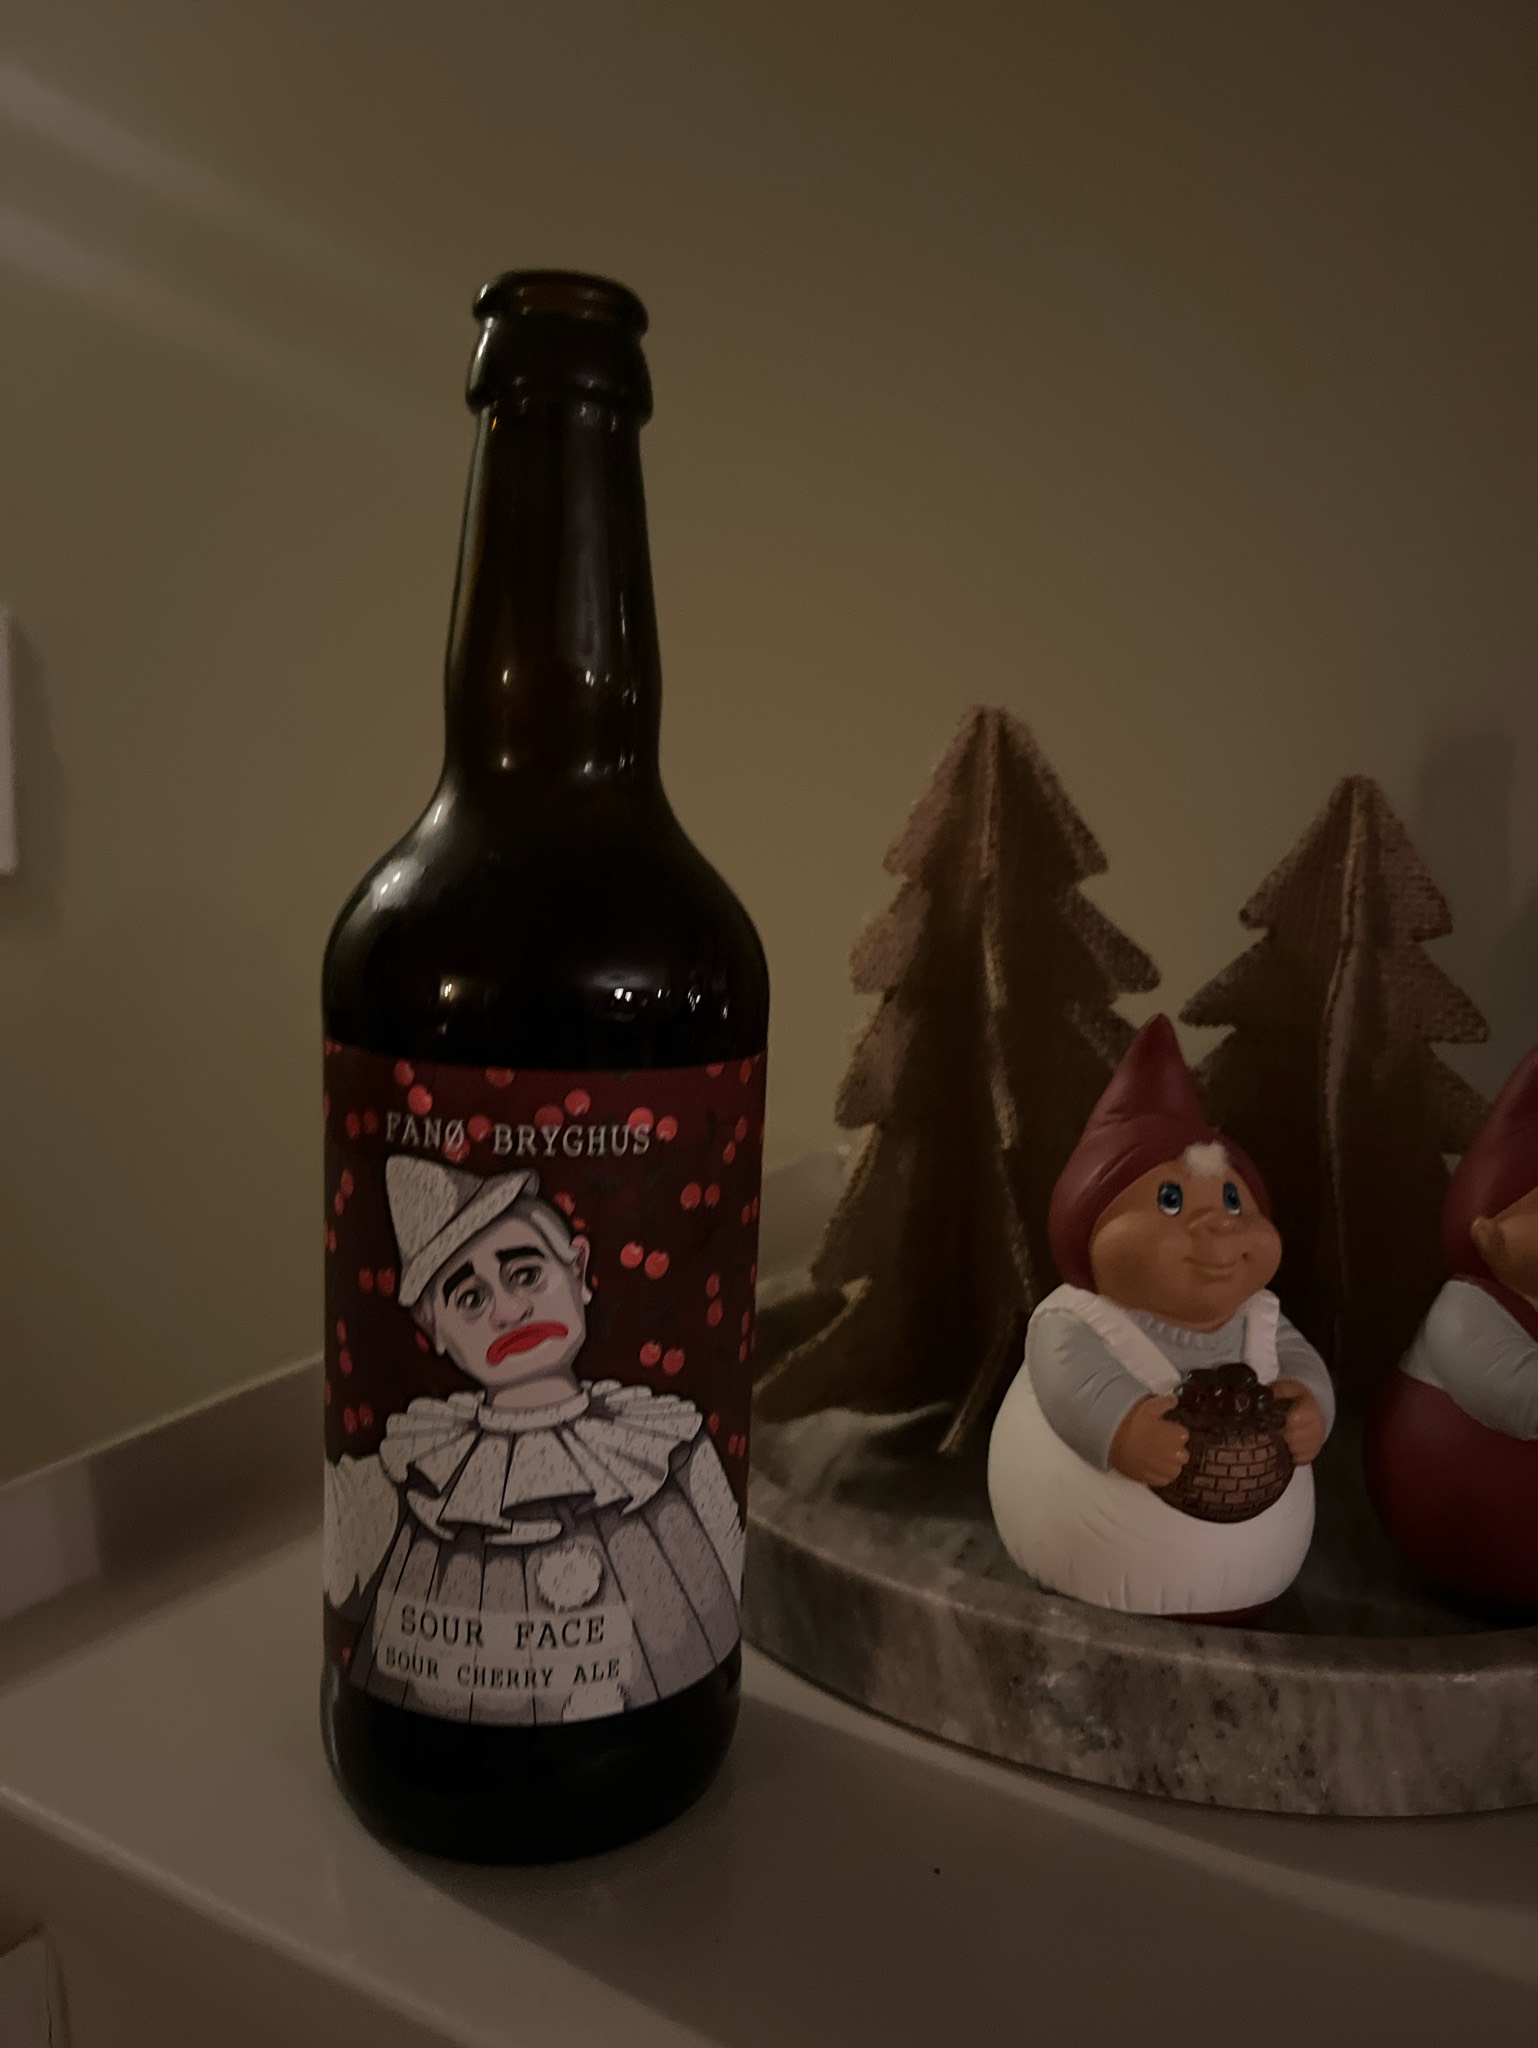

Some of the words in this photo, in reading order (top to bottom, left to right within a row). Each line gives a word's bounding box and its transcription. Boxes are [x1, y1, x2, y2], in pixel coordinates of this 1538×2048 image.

[385, 1110, 466, 1152] FANØ
[491, 1121, 651, 1157] BRYGHUS
[401, 1604, 483, 1649] SOUR
[515, 1614, 605, 1650] FACE
[385, 1646, 439, 1679] SOUR
[456, 1664, 554, 1689] CHERRY
[572, 1657, 620, 1685] ALE
